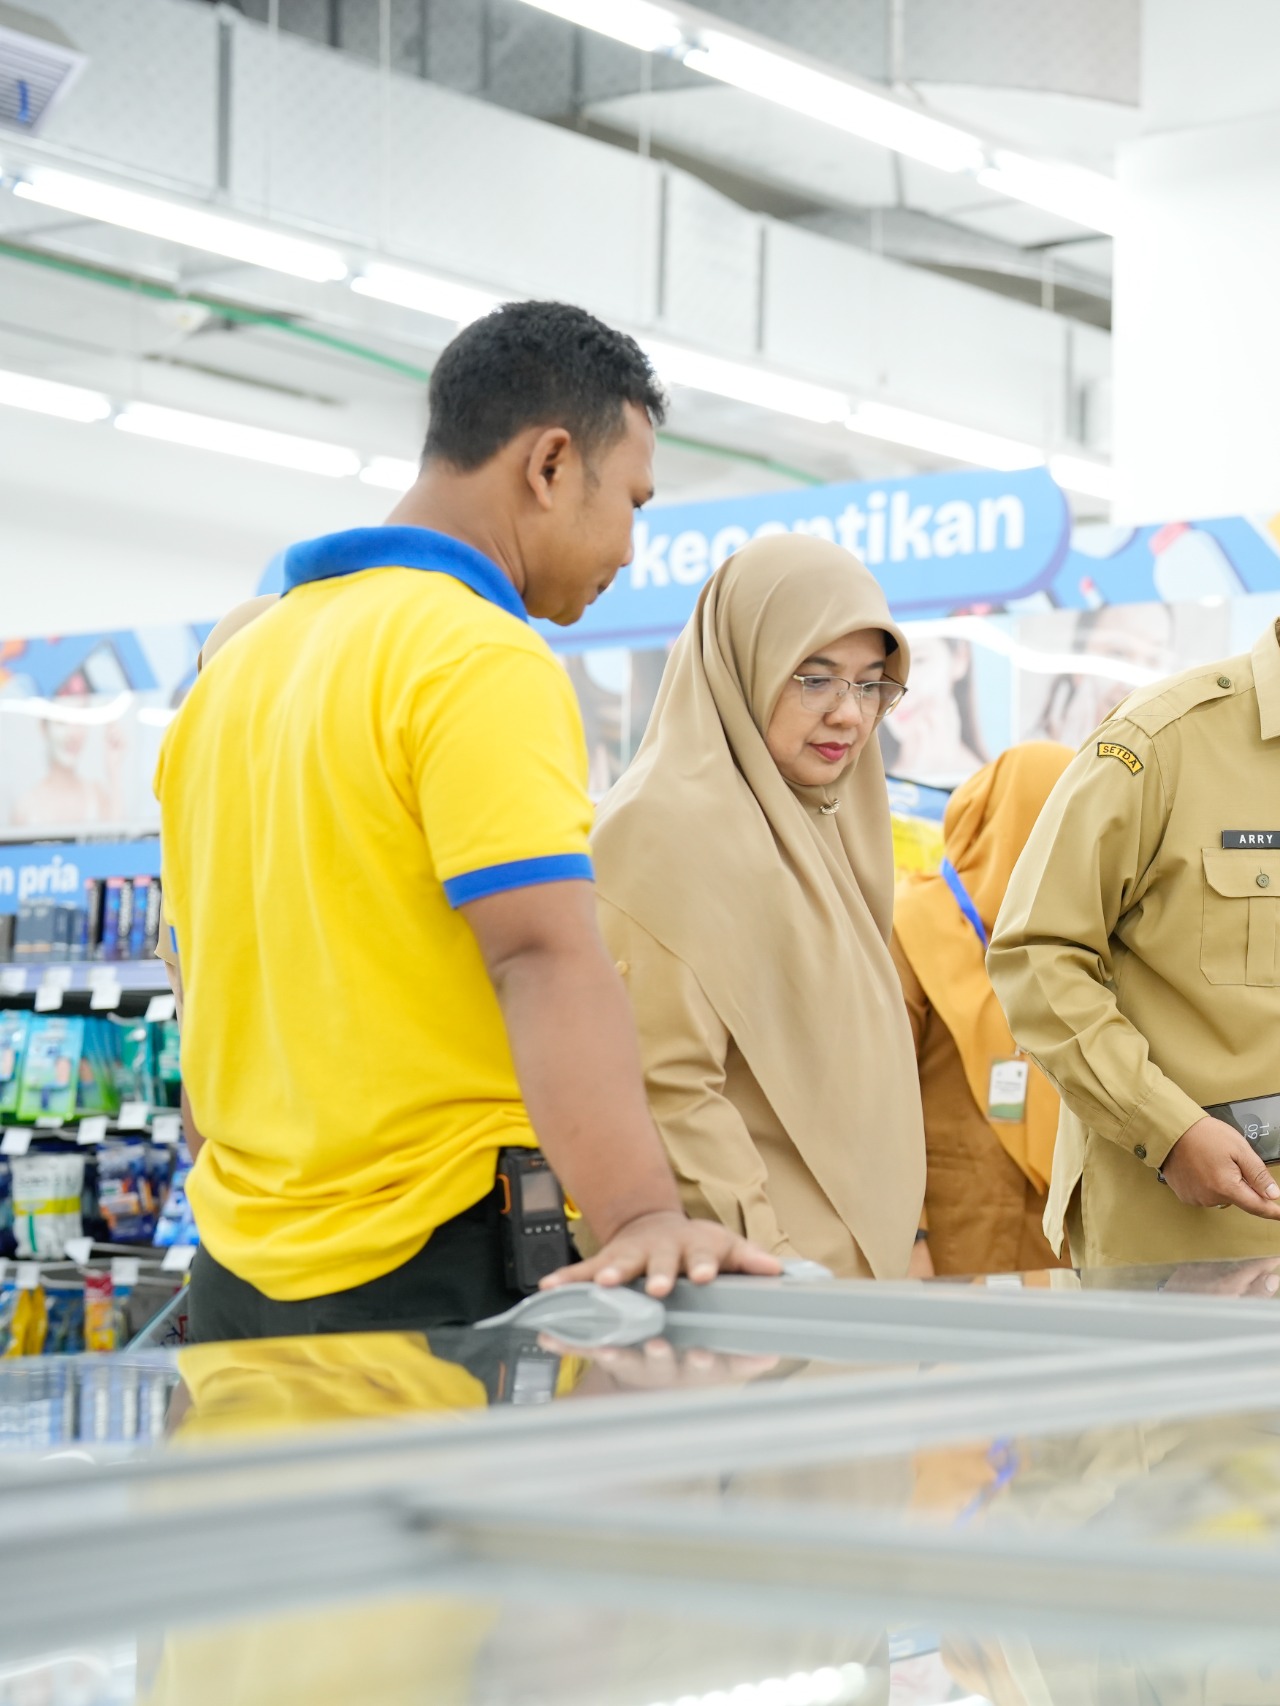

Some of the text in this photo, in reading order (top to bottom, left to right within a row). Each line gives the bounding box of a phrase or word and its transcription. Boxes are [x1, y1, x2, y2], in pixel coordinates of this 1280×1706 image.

[630, 491, 1025, 592] kectikan
[1102, 745, 1138, 769] SETDA
[1239, 834, 1273, 844] ARRY
[18, 854, 80, 904] pria
